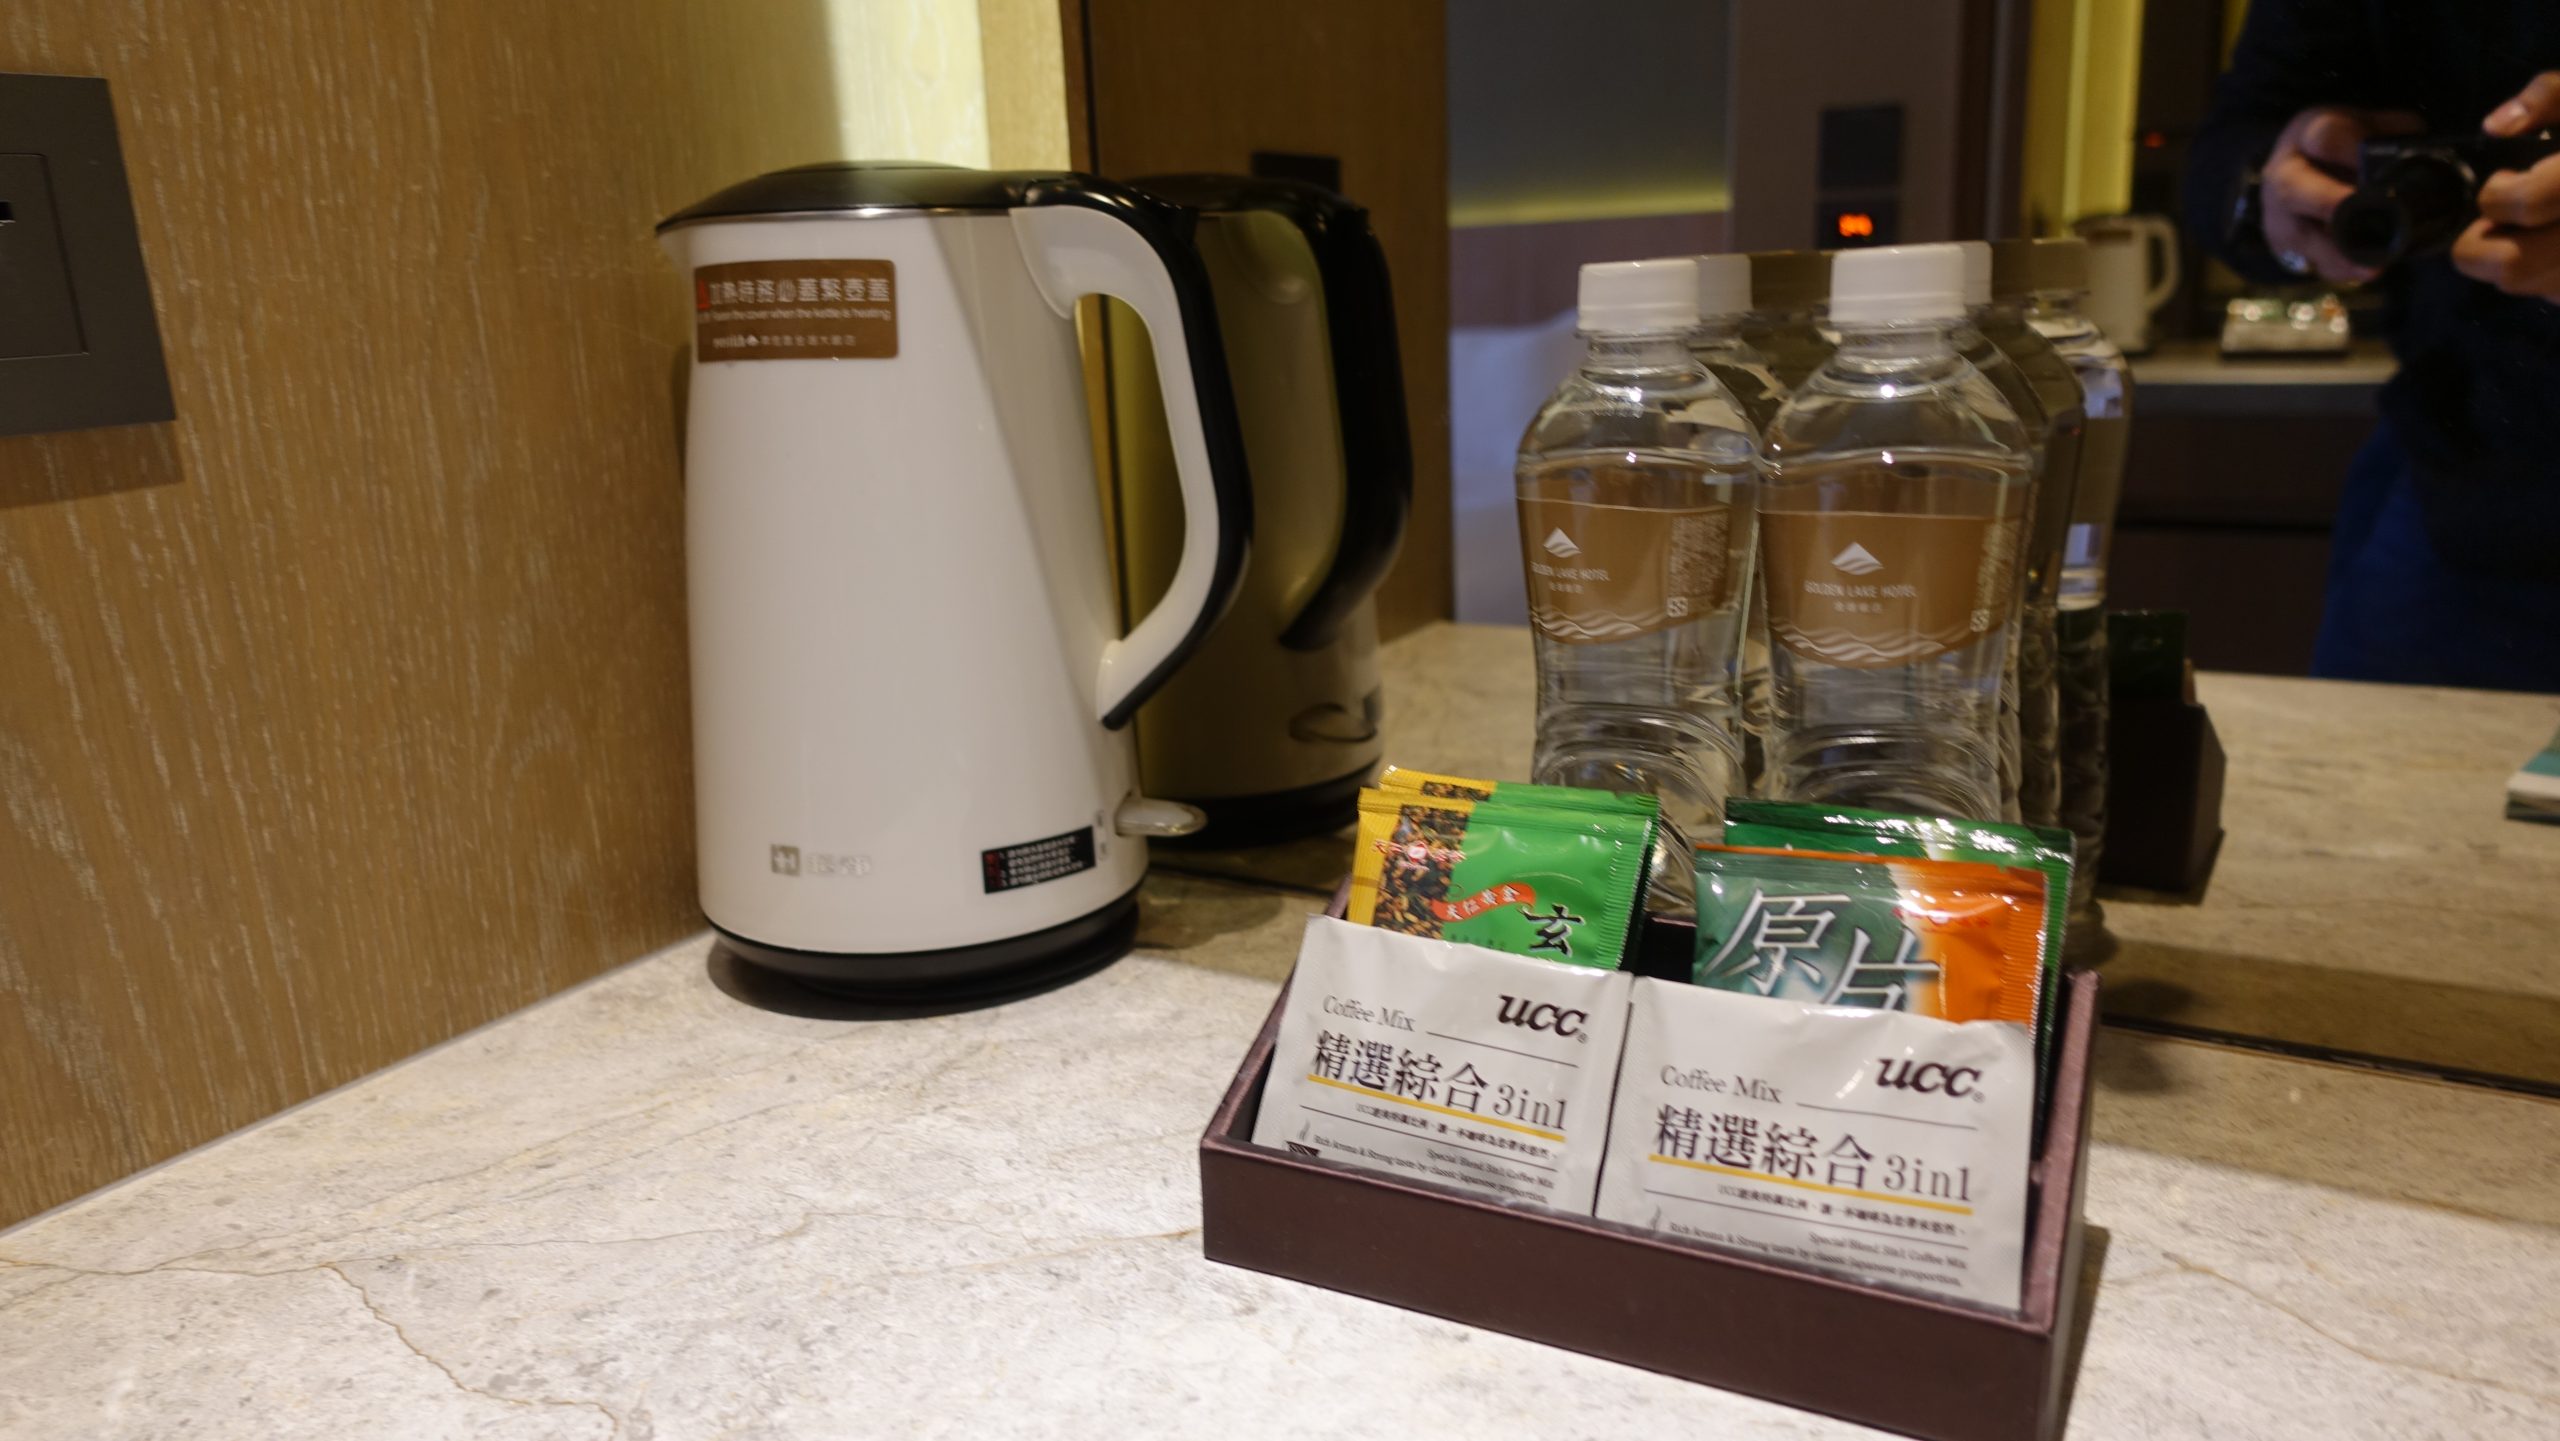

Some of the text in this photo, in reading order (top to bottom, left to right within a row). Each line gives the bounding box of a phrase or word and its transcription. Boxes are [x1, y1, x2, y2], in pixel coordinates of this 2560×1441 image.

[1517, 902, 1586, 958] 玄
[1703, 886, 1943, 1011] 原片
[1323, 994, 1416, 1034] Coffee Mix
[1660, 1064, 1783, 1105] Coffee Mix
